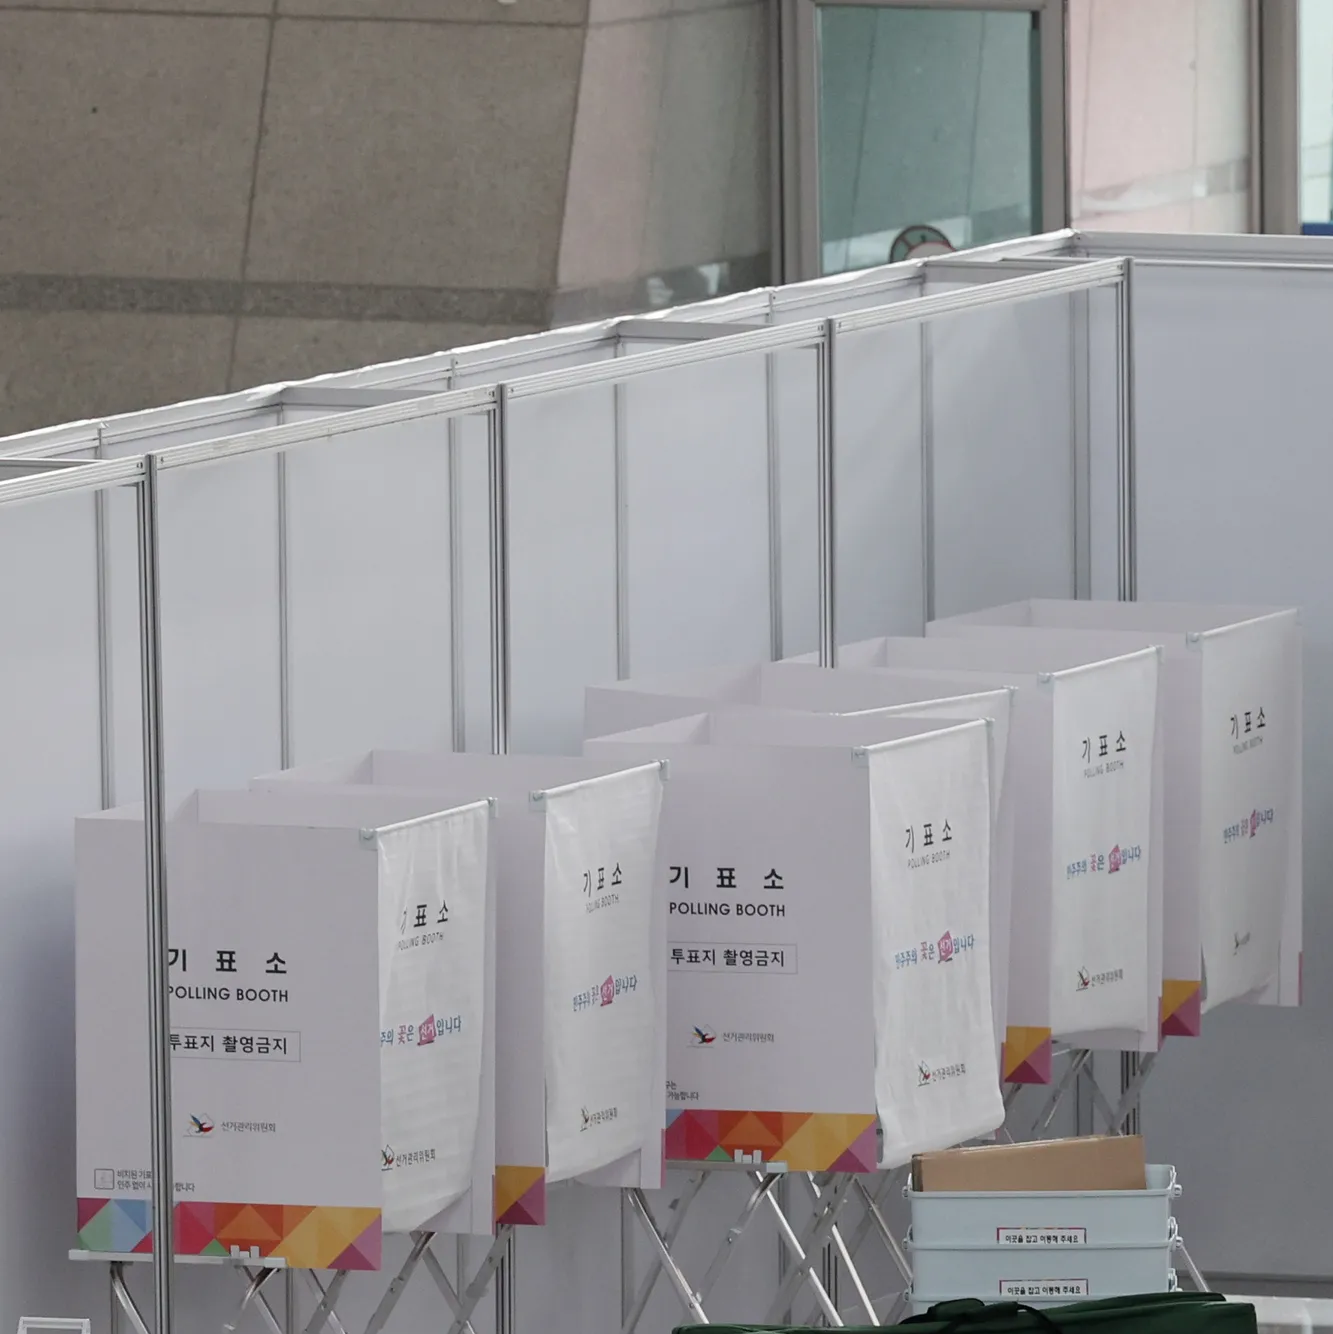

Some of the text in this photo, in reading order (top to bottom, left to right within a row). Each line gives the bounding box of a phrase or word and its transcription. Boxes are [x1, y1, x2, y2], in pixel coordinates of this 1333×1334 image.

[669, 902, 785, 917] POLLING BOOTH
[670, 949, 784, 967] 투표지 촬영금지
[236, 988, 288, 1002] BOOTH
[169, 1034, 287, 1054] 투표지 촬영금지
